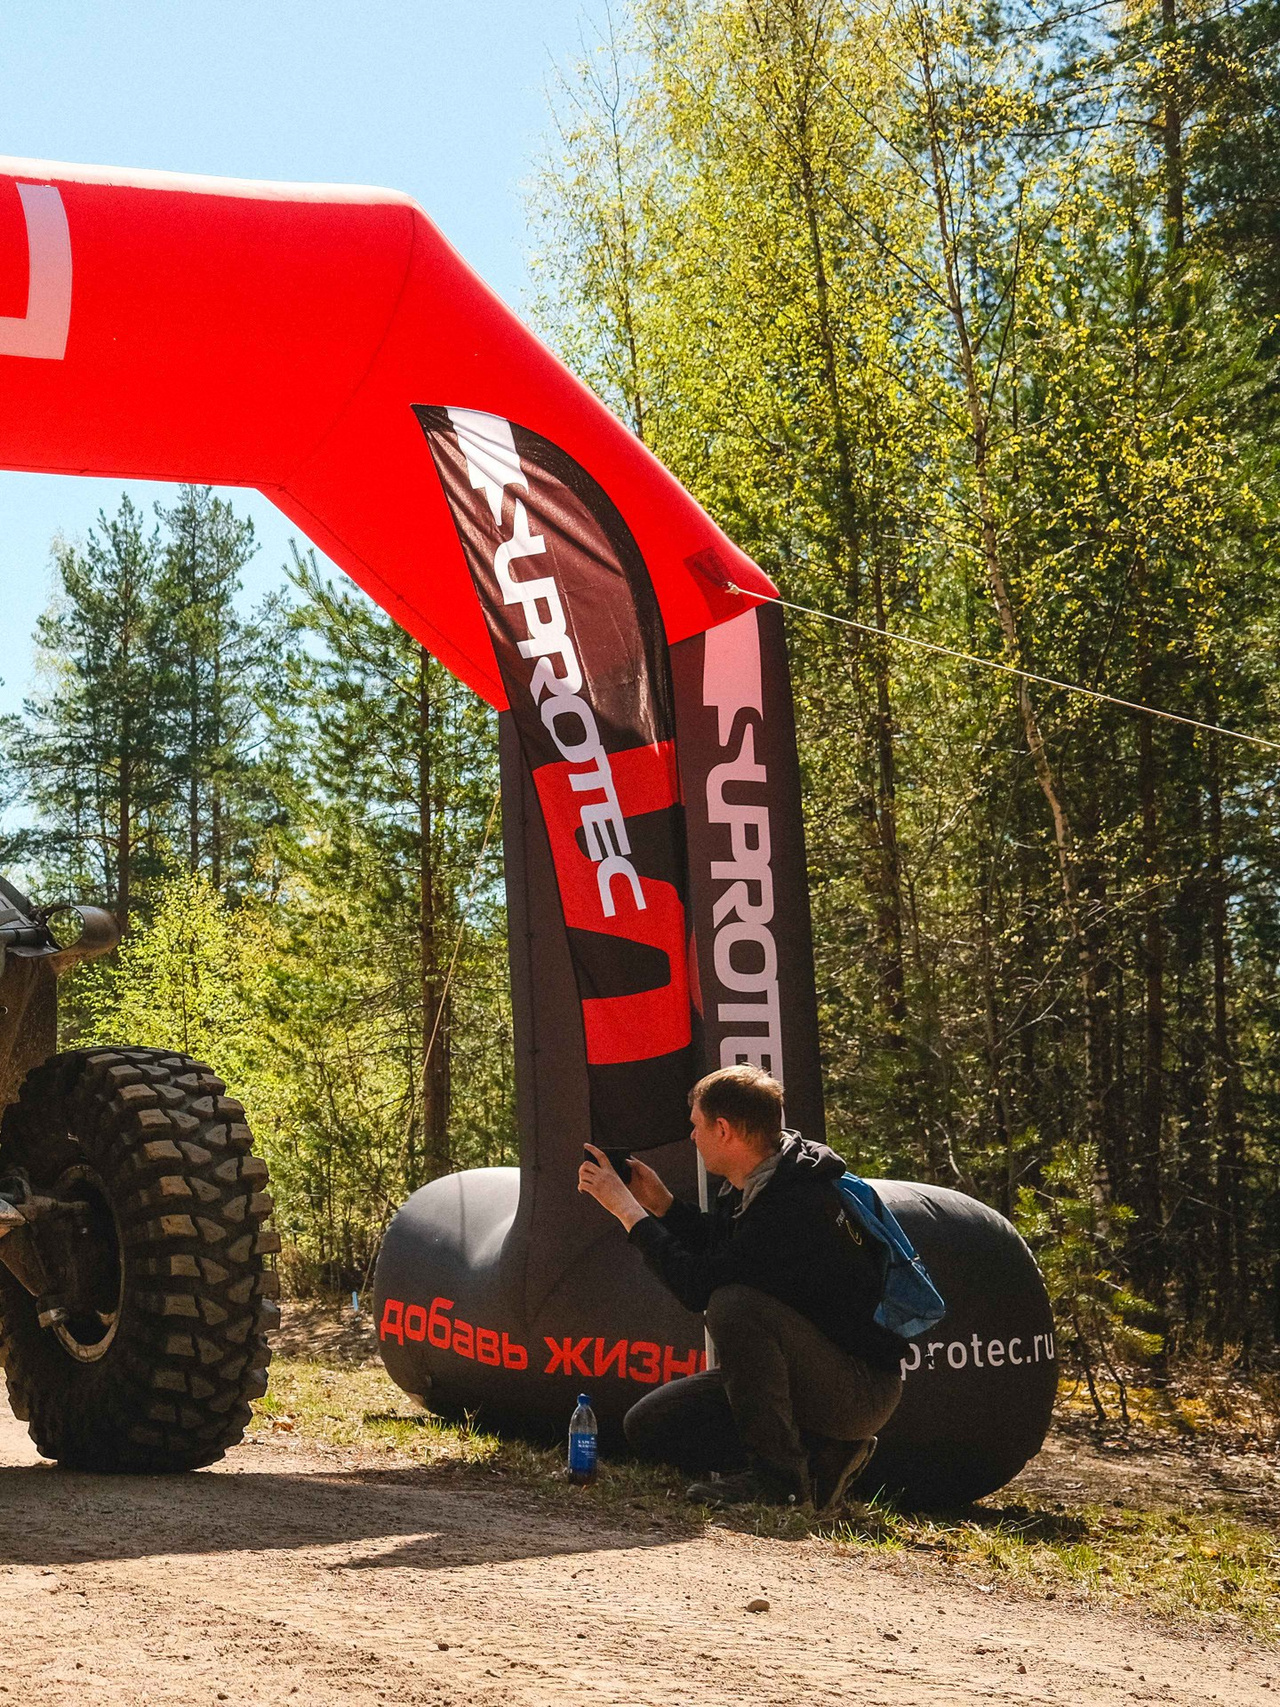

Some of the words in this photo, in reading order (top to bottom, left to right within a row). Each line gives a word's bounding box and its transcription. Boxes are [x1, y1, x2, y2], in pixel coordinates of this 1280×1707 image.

[474, 480, 647, 918] SUPROTEC
[706, 700, 784, 1088] SUPROTE
[380, 1297, 528, 1370] добавь
[544, 1336, 707, 1384] жизн
